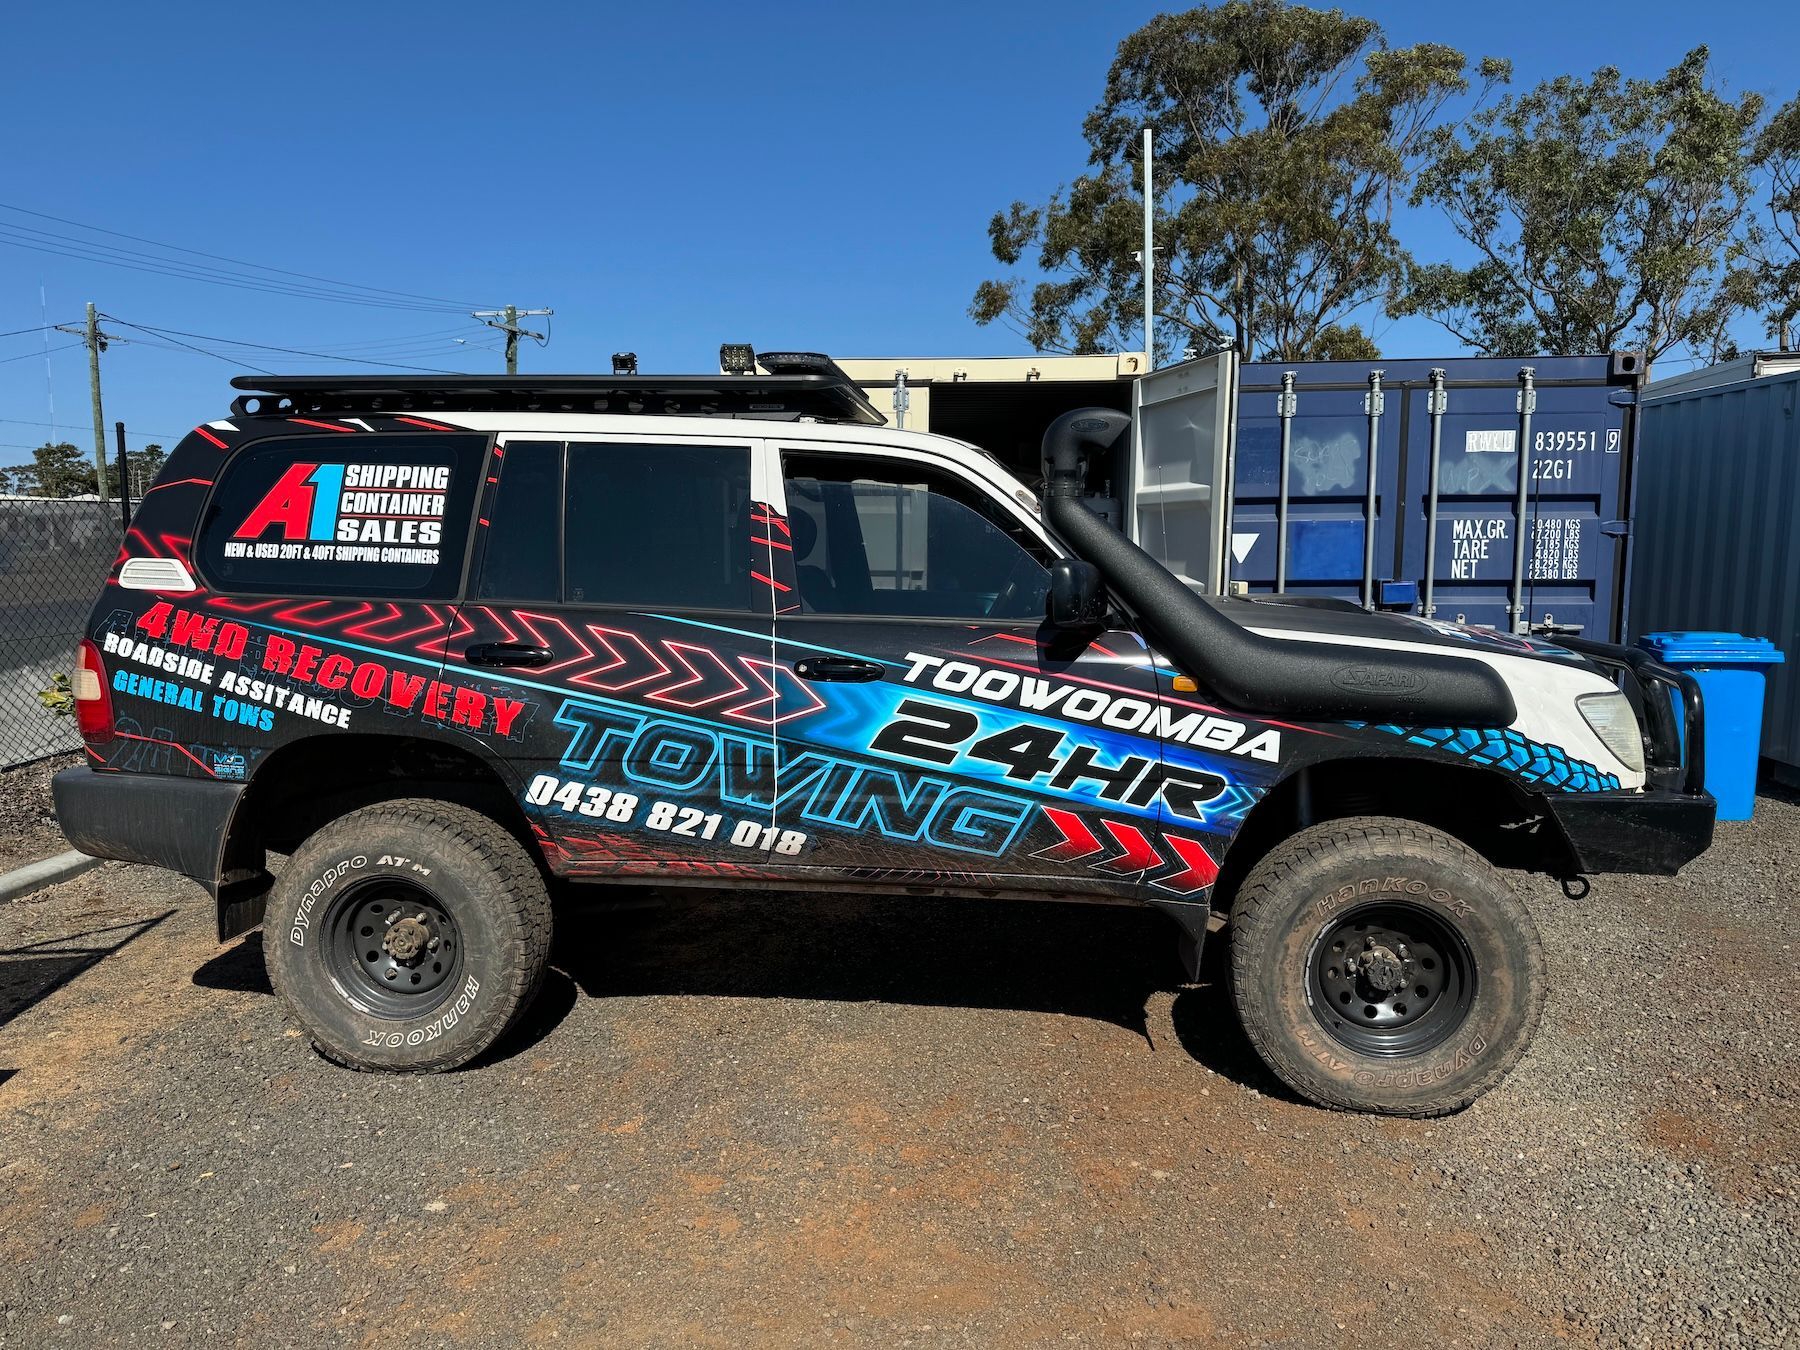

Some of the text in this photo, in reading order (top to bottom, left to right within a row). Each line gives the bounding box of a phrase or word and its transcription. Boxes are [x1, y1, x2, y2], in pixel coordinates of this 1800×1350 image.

[1535, 431, 1596, 451] 839551
[1606, 431, 1619, 451] 9
[345, 464, 449, 489] SHIPPING
[1532, 459, 1572, 479] 22G1
[233, 464, 344, 540] A1
[341, 492, 445, 515] CONTAINER
[337, 519, 441, 544] SALES
[1453, 520, 1509, 539] MAX.GR.
[1564, 529, 1580, 539] LBS
[1565, 519, 1581, 529] KGS
[224, 542, 440, 565] NEW & USED 20FT & 40FT SHIPPING CONTAINERS
[1453, 540, 1489, 559] TARE
[1535, 550, 1579, 559] 4.820 LBS
[1536, 540, 1579, 549] 2.185 KGS
[1451, 559, 1478, 579] NET
[1562, 559, 1578, 569] KGS
[1562, 569, 1578, 579] LBS
[136, 601, 525, 736] 4WD RECOVERY
[1342, 665, 1416, 688] SAFARI
[103, 631, 352, 730] ROADSIDE ASSITANCE
[113, 670, 275, 731] GENERAL TOWS
[903, 651, 1281, 763] TOOWOOMBA
[868, 699, 1227, 823] 24HR
[553, 698, 1034, 857] TOWING
[525, 774, 807, 856] 0438 821 018
